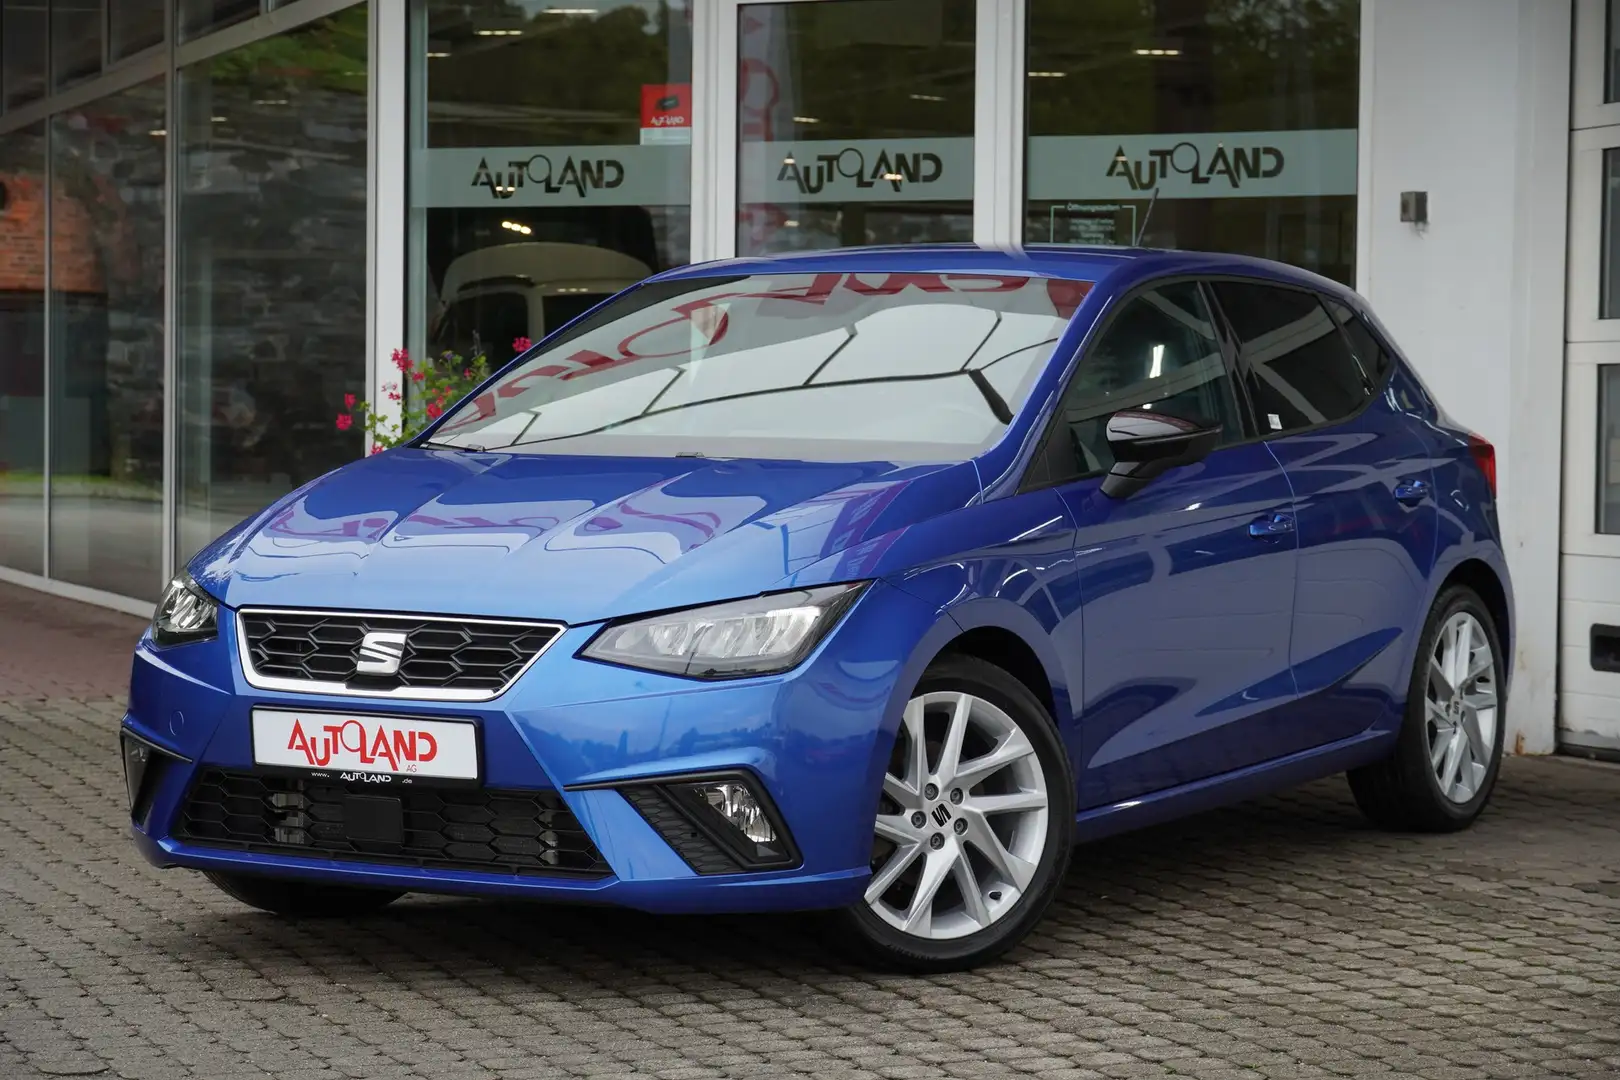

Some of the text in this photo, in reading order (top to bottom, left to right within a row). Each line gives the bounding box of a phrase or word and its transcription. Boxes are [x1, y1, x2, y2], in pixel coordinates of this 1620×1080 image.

[471, 154, 625, 198] AUTOLAND
[777, 147, 943, 194] AUTOLAND
[1106, 142, 1285, 190] AUTOLAND
[288, 718, 437, 771] AUTOLAND
[340, 772, 391, 783] AUTOLAND
[406, 764, 418, 773] AG
